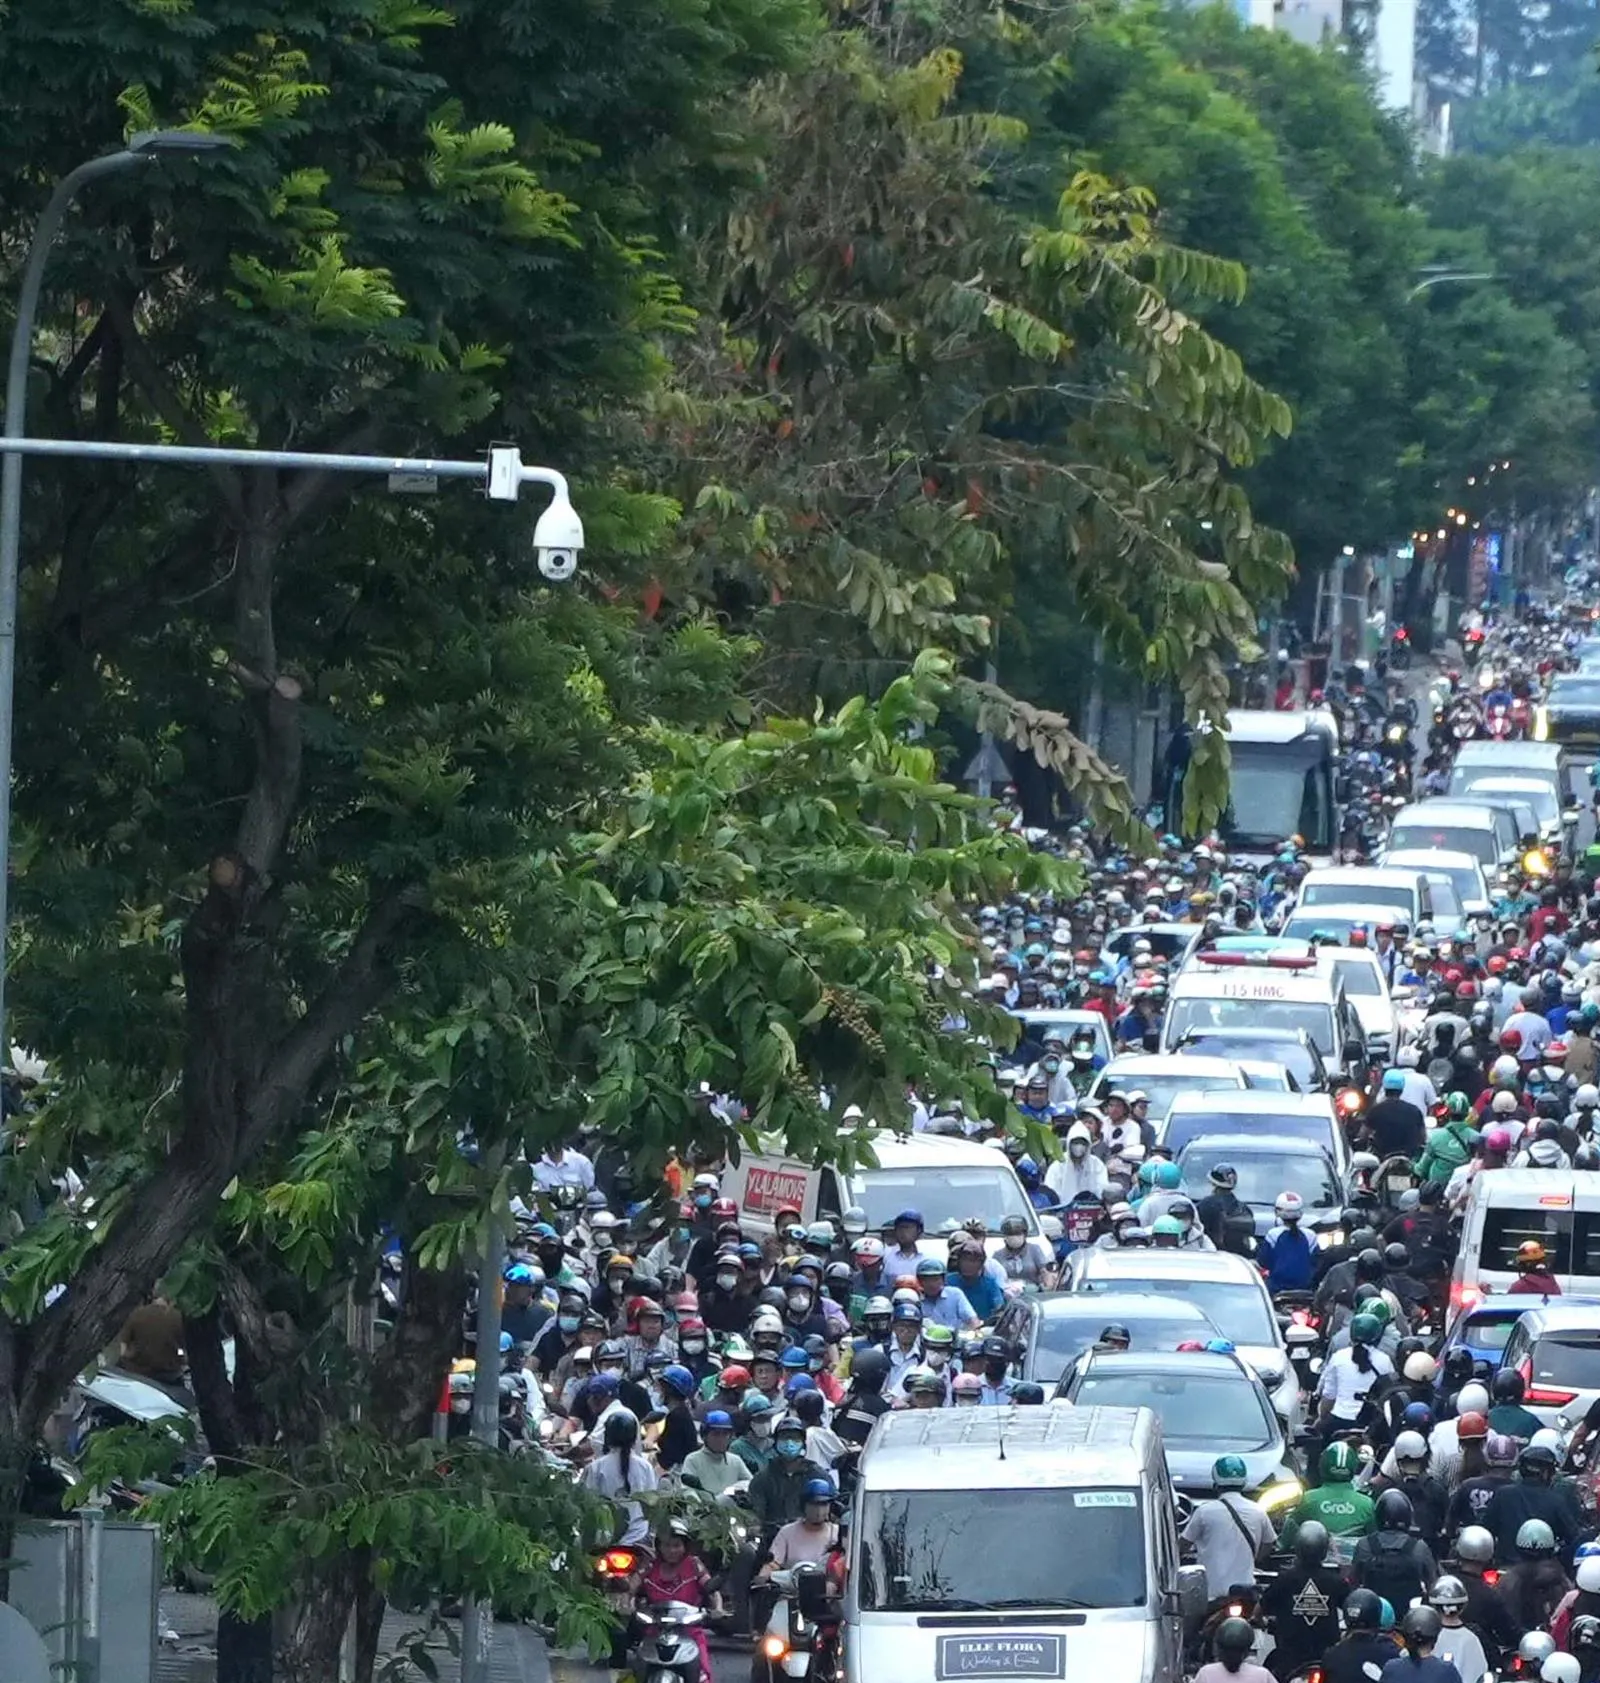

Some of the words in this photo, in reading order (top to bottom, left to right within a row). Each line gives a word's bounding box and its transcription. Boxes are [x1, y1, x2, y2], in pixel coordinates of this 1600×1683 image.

[1222, 983, 1248, 997] 115
[1320, 1500, 1356, 1515] Grab
[959, 1643, 994, 1654] ELLE
[996, 1643, 1044, 1654] FLORA
